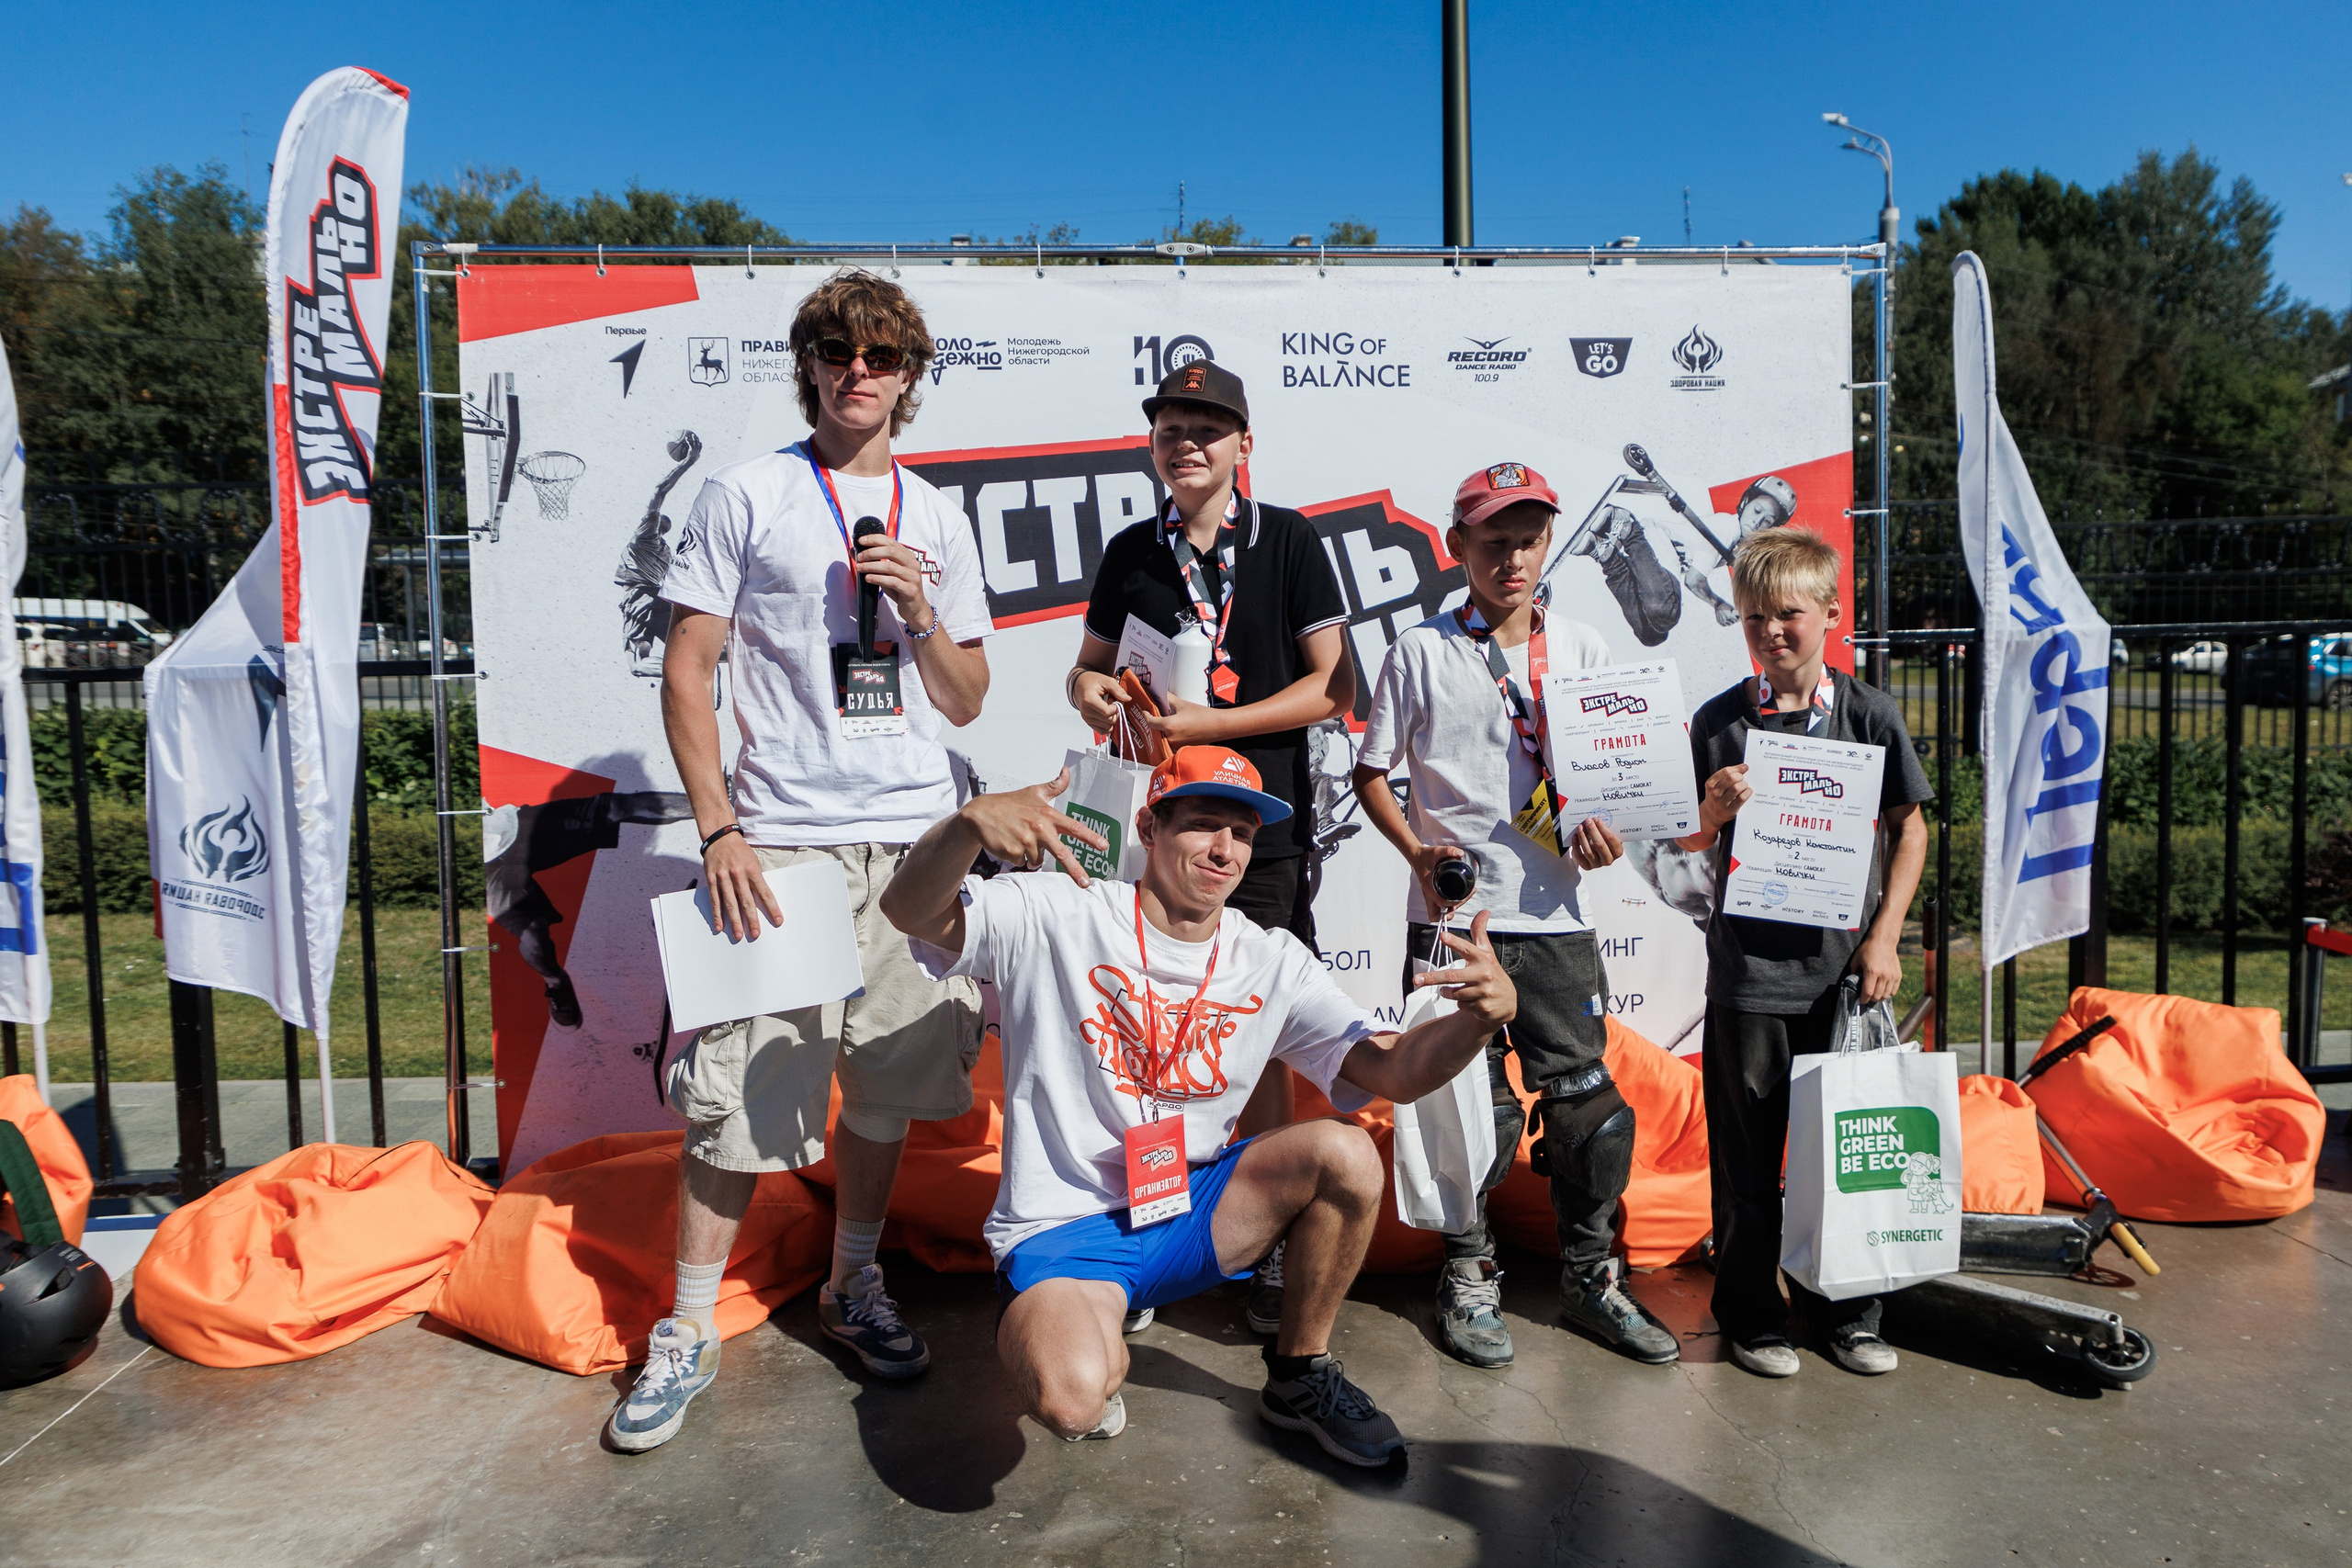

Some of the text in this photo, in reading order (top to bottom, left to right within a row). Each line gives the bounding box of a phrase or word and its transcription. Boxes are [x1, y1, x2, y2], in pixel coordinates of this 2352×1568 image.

[334, 174, 368, 264] НО
[317, 217, 375, 378] МАЛЬ
[605, 326, 647, 336] Первые
[1007, 337, 1061, 346] Молодежь
[1282, 332, 1386, 355] KING OF
[1589, 342, 1614, 355] LET'S
[1008, 346, 1090, 356] Нижегородской
[1009, 356, 1050, 365] области
[1586, 355, 1618, 373] GO
[742, 372, 791, 382] ОБЛАС
[1474, 373, 1499, 382] 100.9
[1670, 379, 1702, 388] ЗДОРОВАЯ
[294, 300, 367, 490] ЭКСТРЕ
[921, 561, 937, 572] АЛЬ
[847, 692, 893, 710] СУДЬЯ
[1582, 694, 1618, 710] ЭКСТРЕ
[1607, 699, 1635, 715] МАЛЬ
[1630, 700, 1646, 713] НО
[1593, 733, 1646, 751] ГРАМОТА
[1618, 773, 1623, 781] 3
[1781, 769, 1815, 782] ЭКСТРЕ
[1804, 778, 1833, 792] МАЛЬ
[1824, 784, 1841, 796] НО
[1780, 813, 1832, 831] ГРАМОТА
[1794, 852, 1800, 860] 2
[1084, 853, 1110, 876] ECO
[1804, 864, 1826, 873] САМОКАТ
[1320, 950, 1371, 971] БОЛ
[1839, 1115, 1897, 1137] THINK
[1840, 1134, 1904, 1156] GREEN
[1841, 1152, 1911, 1174] BE ECO
[1134, 1175, 1182, 1199] ОРГАНИЗАТОР
[1881, 1229, 1943, 1244] SYNERGETIC
